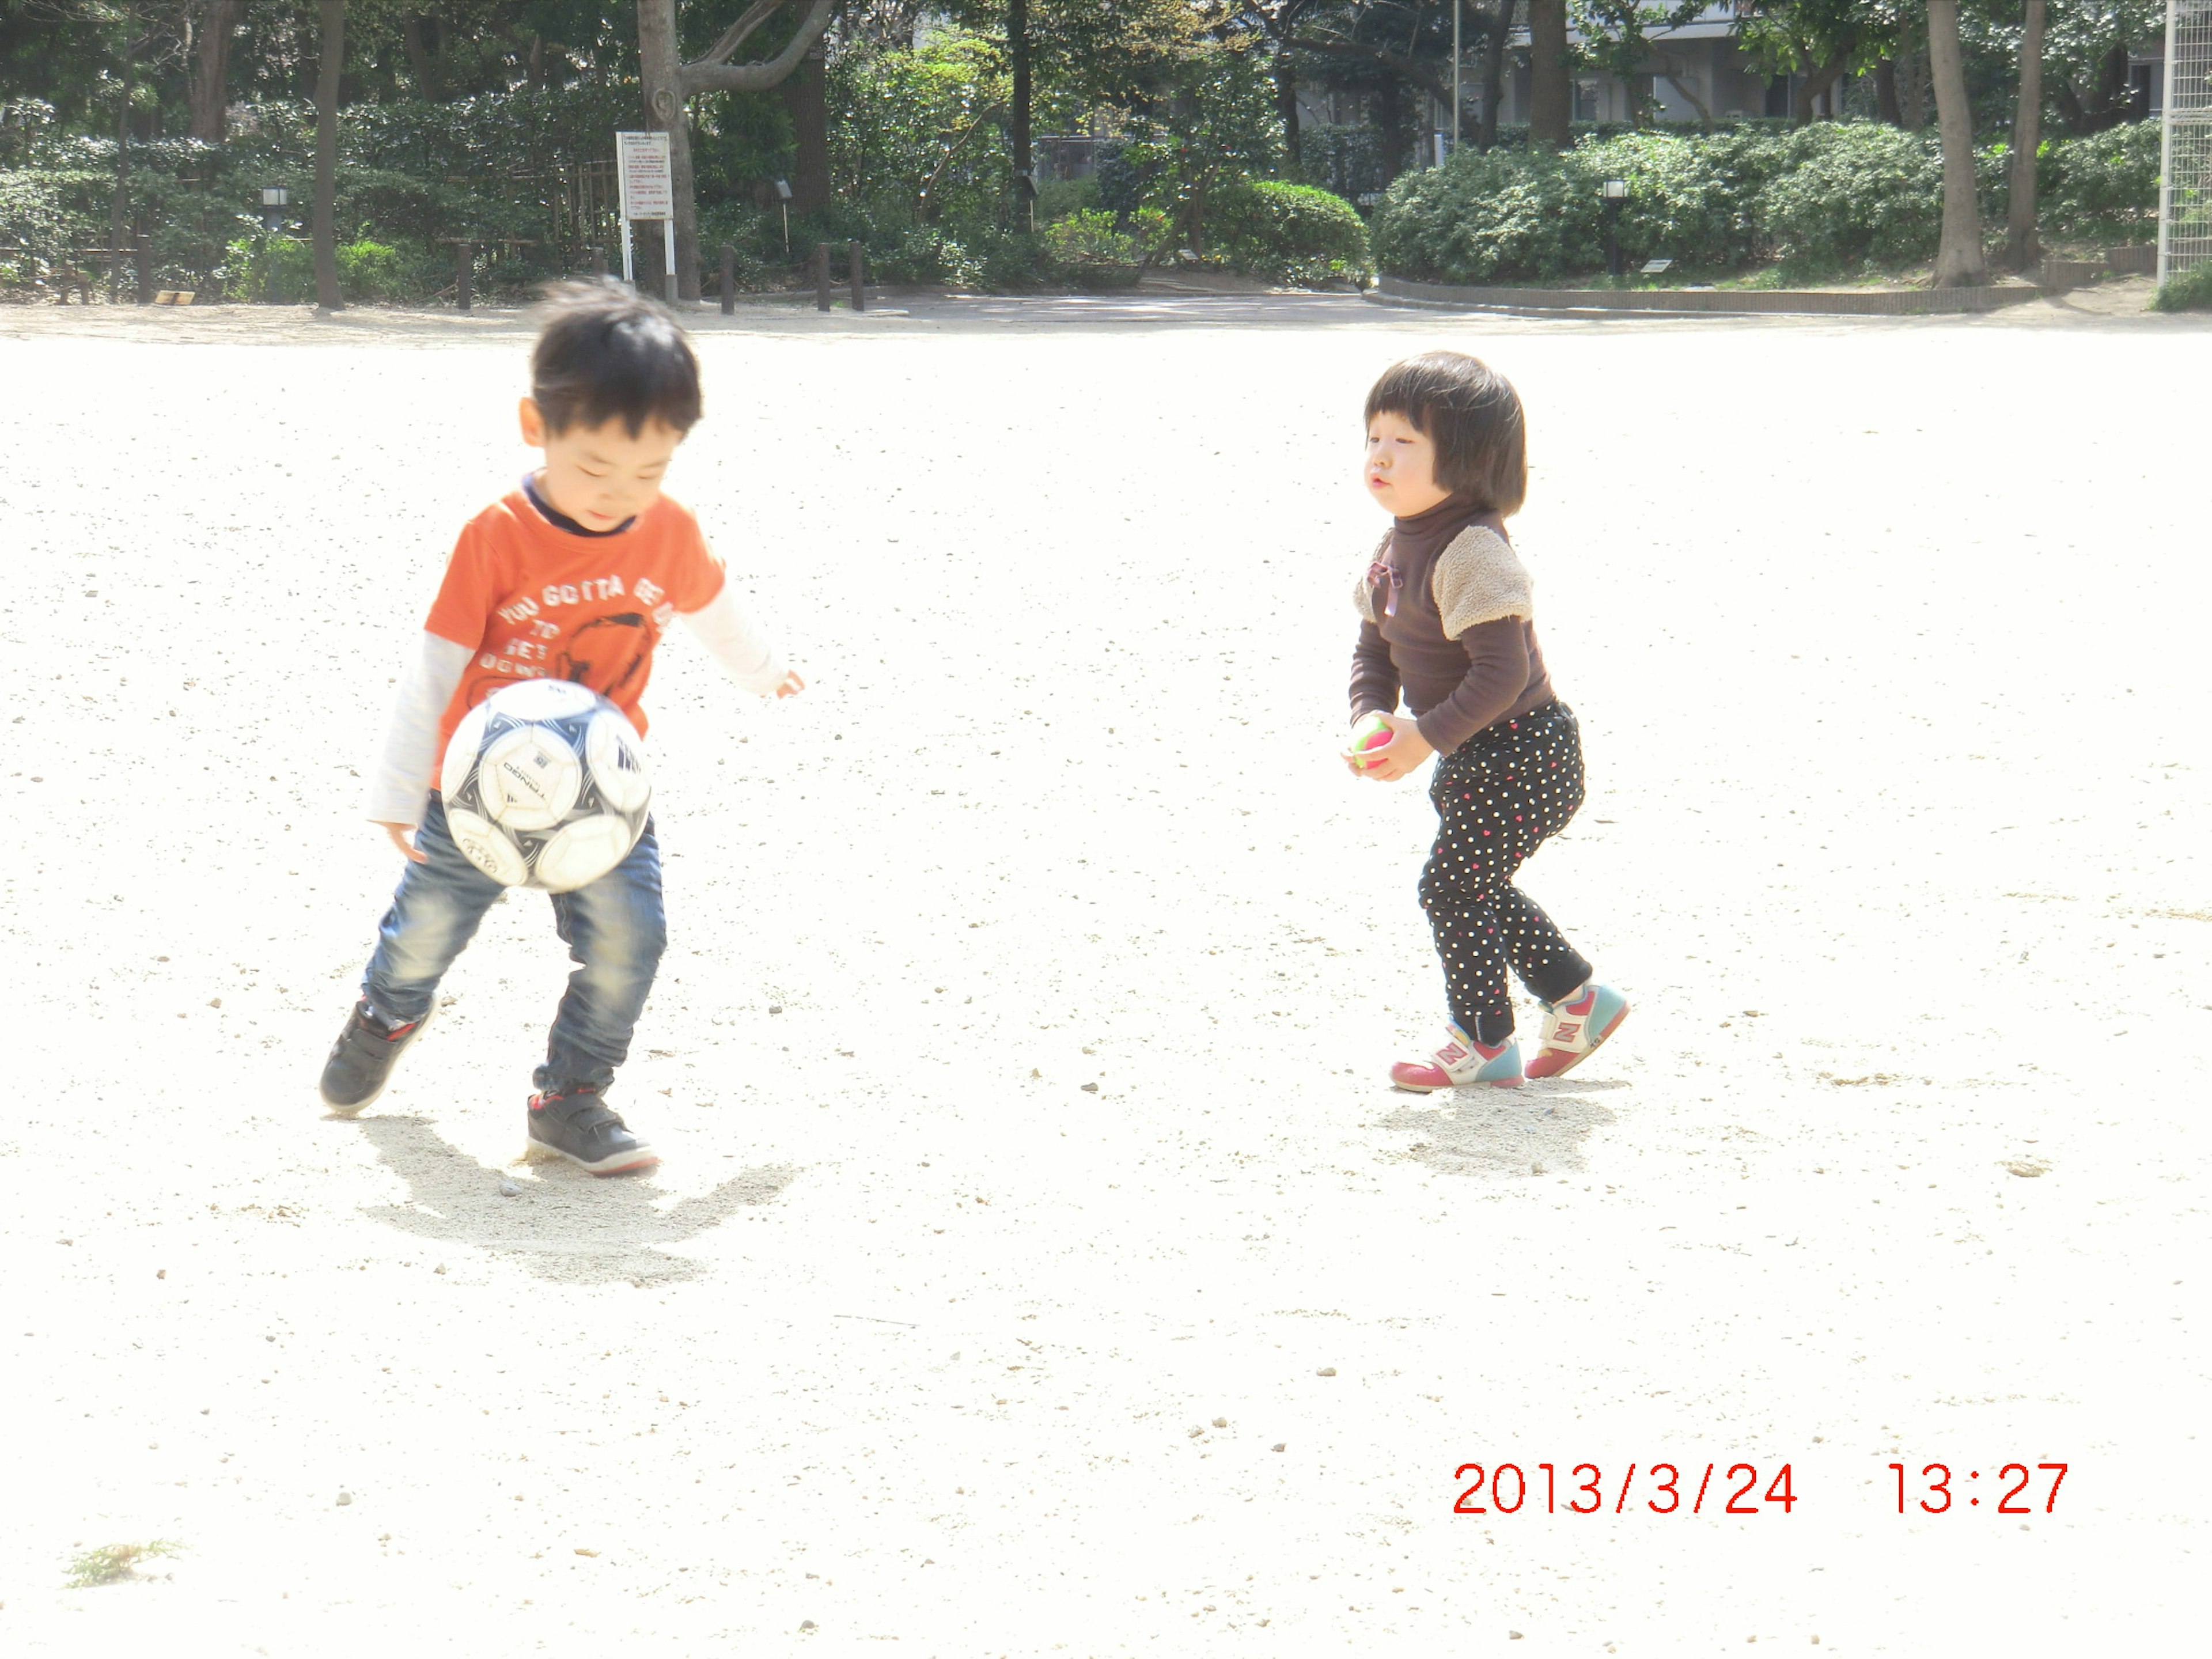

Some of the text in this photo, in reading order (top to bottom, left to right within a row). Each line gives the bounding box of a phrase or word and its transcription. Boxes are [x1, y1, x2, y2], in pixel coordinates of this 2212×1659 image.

[498, 596, 540, 625] YOU
[542, 574, 625, 607] GOTTA
[503, 762, 547, 801] TANGO
[1553, 1022, 1581, 1043] N
[1436, 1042, 1468, 1066] N
